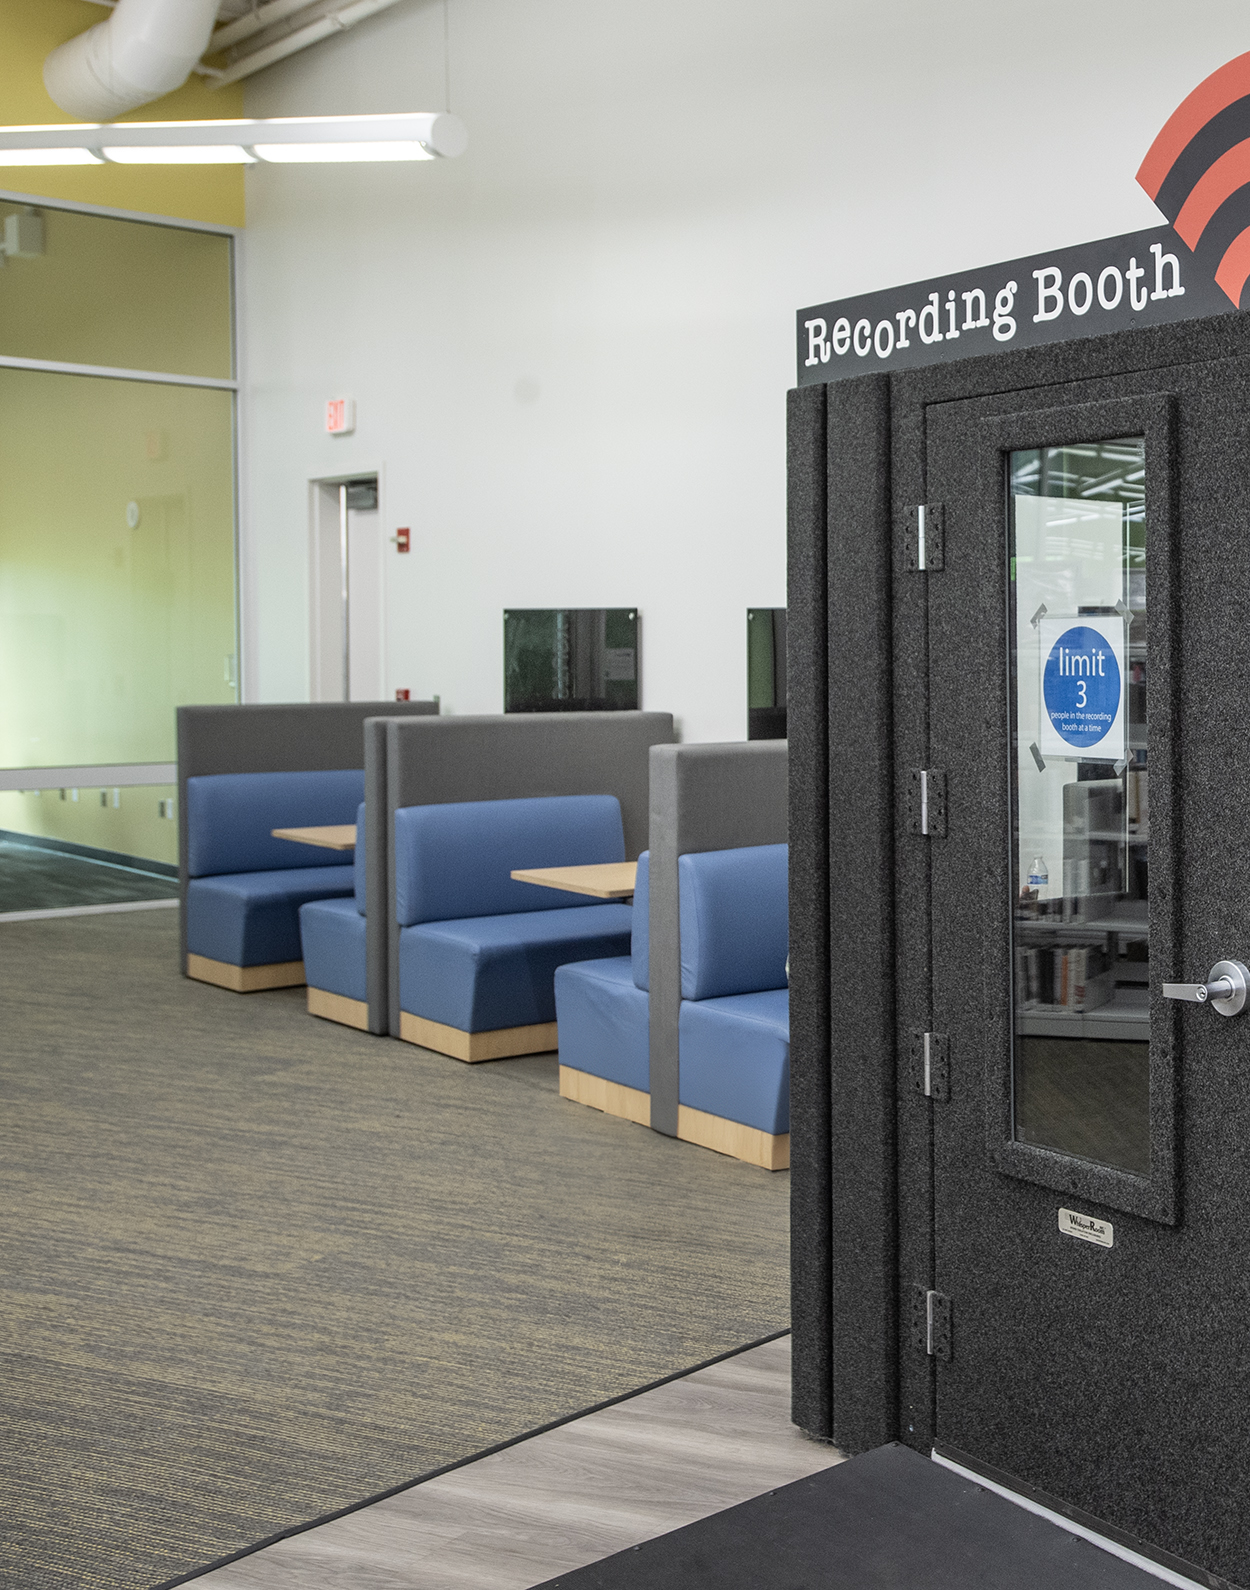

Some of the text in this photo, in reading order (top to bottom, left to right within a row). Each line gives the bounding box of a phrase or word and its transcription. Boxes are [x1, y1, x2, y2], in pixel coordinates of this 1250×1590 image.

[805, 243, 1186, 367] Recording Booth
[1059, 647, 1105, 677] limit
[1075, 680, 1087, 708] 3
[1050, 711, 1112, 723] people in the recording
[1062, 722, 1078, 731] booth
[1089, 724, 1102, 732] time
